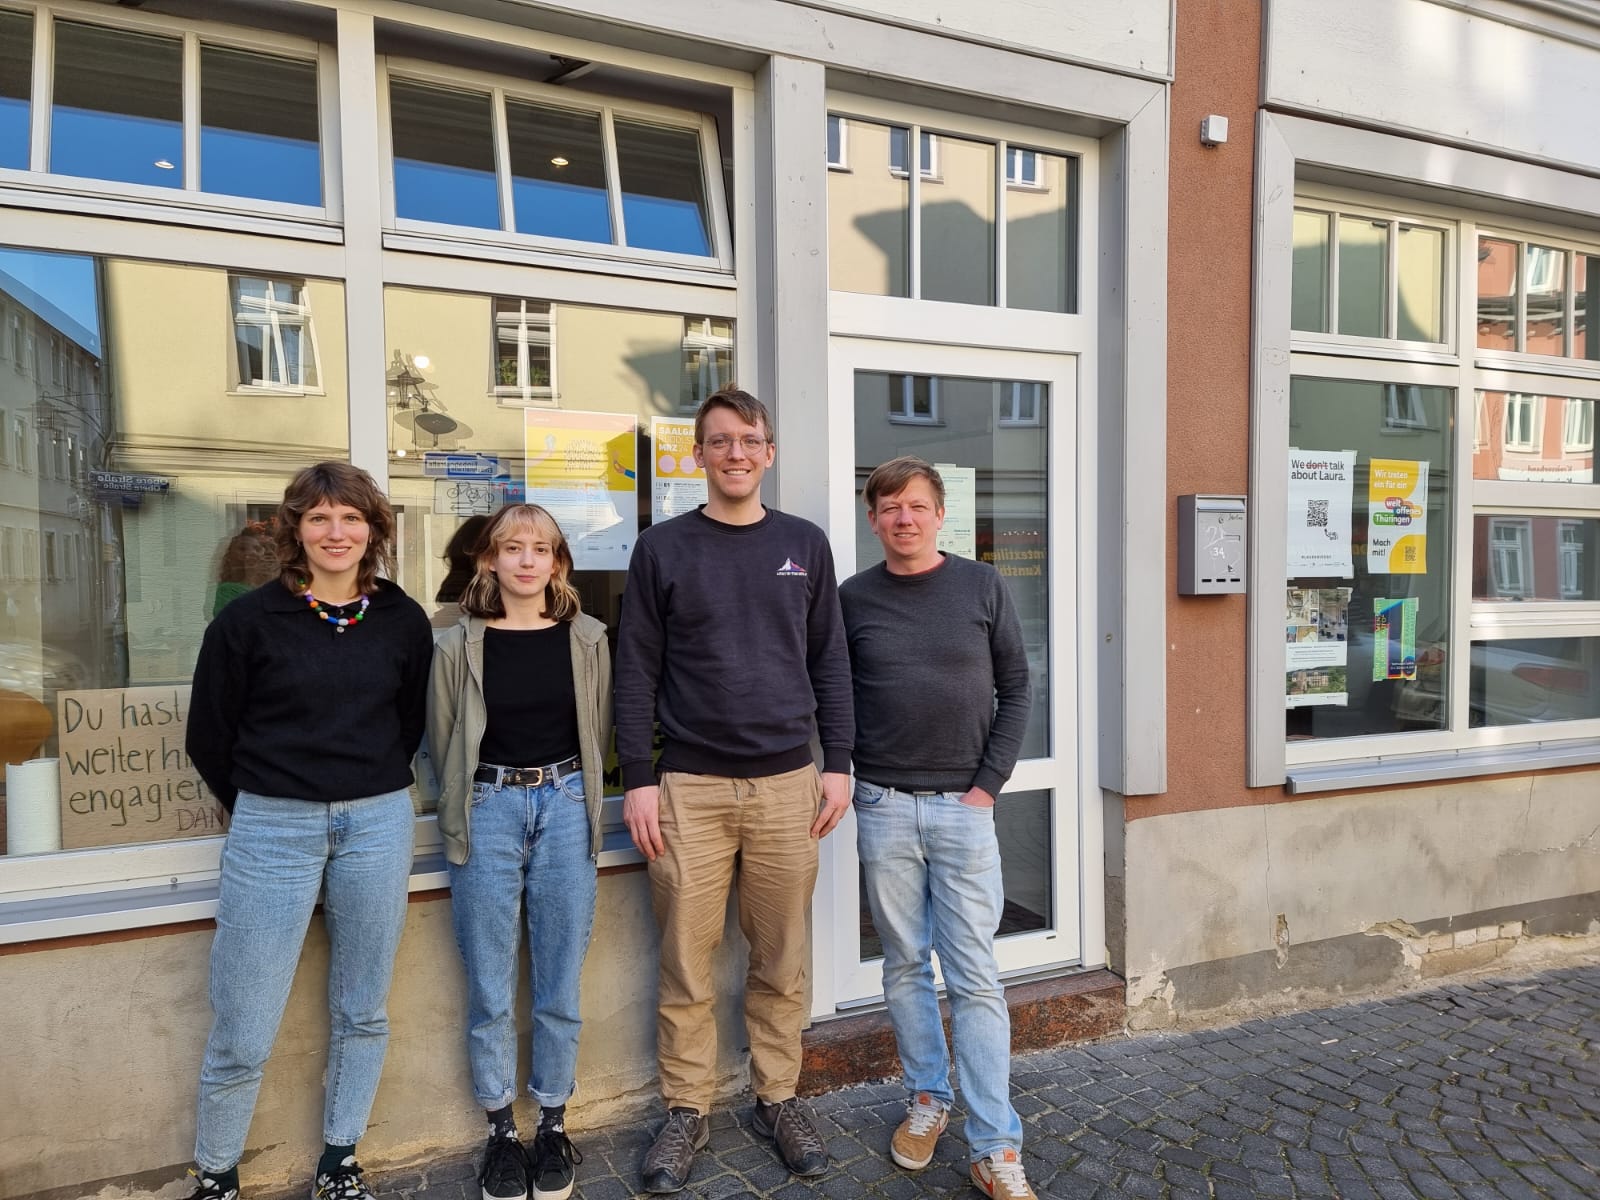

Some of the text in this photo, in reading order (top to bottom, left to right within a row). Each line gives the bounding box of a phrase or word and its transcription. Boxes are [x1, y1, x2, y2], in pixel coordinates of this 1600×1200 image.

[1291, 459, 1345, 471] We don't talk
[1291, 470, 1346, 481] about Laura.
[1374, 469, 1408, 479] Wir treten
[1385, 480, 1396, 489] für
[1386, 499, 1402, 508] welt
[1375, 512, 1410, 525] Thüringen
[1372, 538, 1391, 547] Mach
[64, 690, 183, 733] Du hast
[69, 778, 205, 827] engagier
